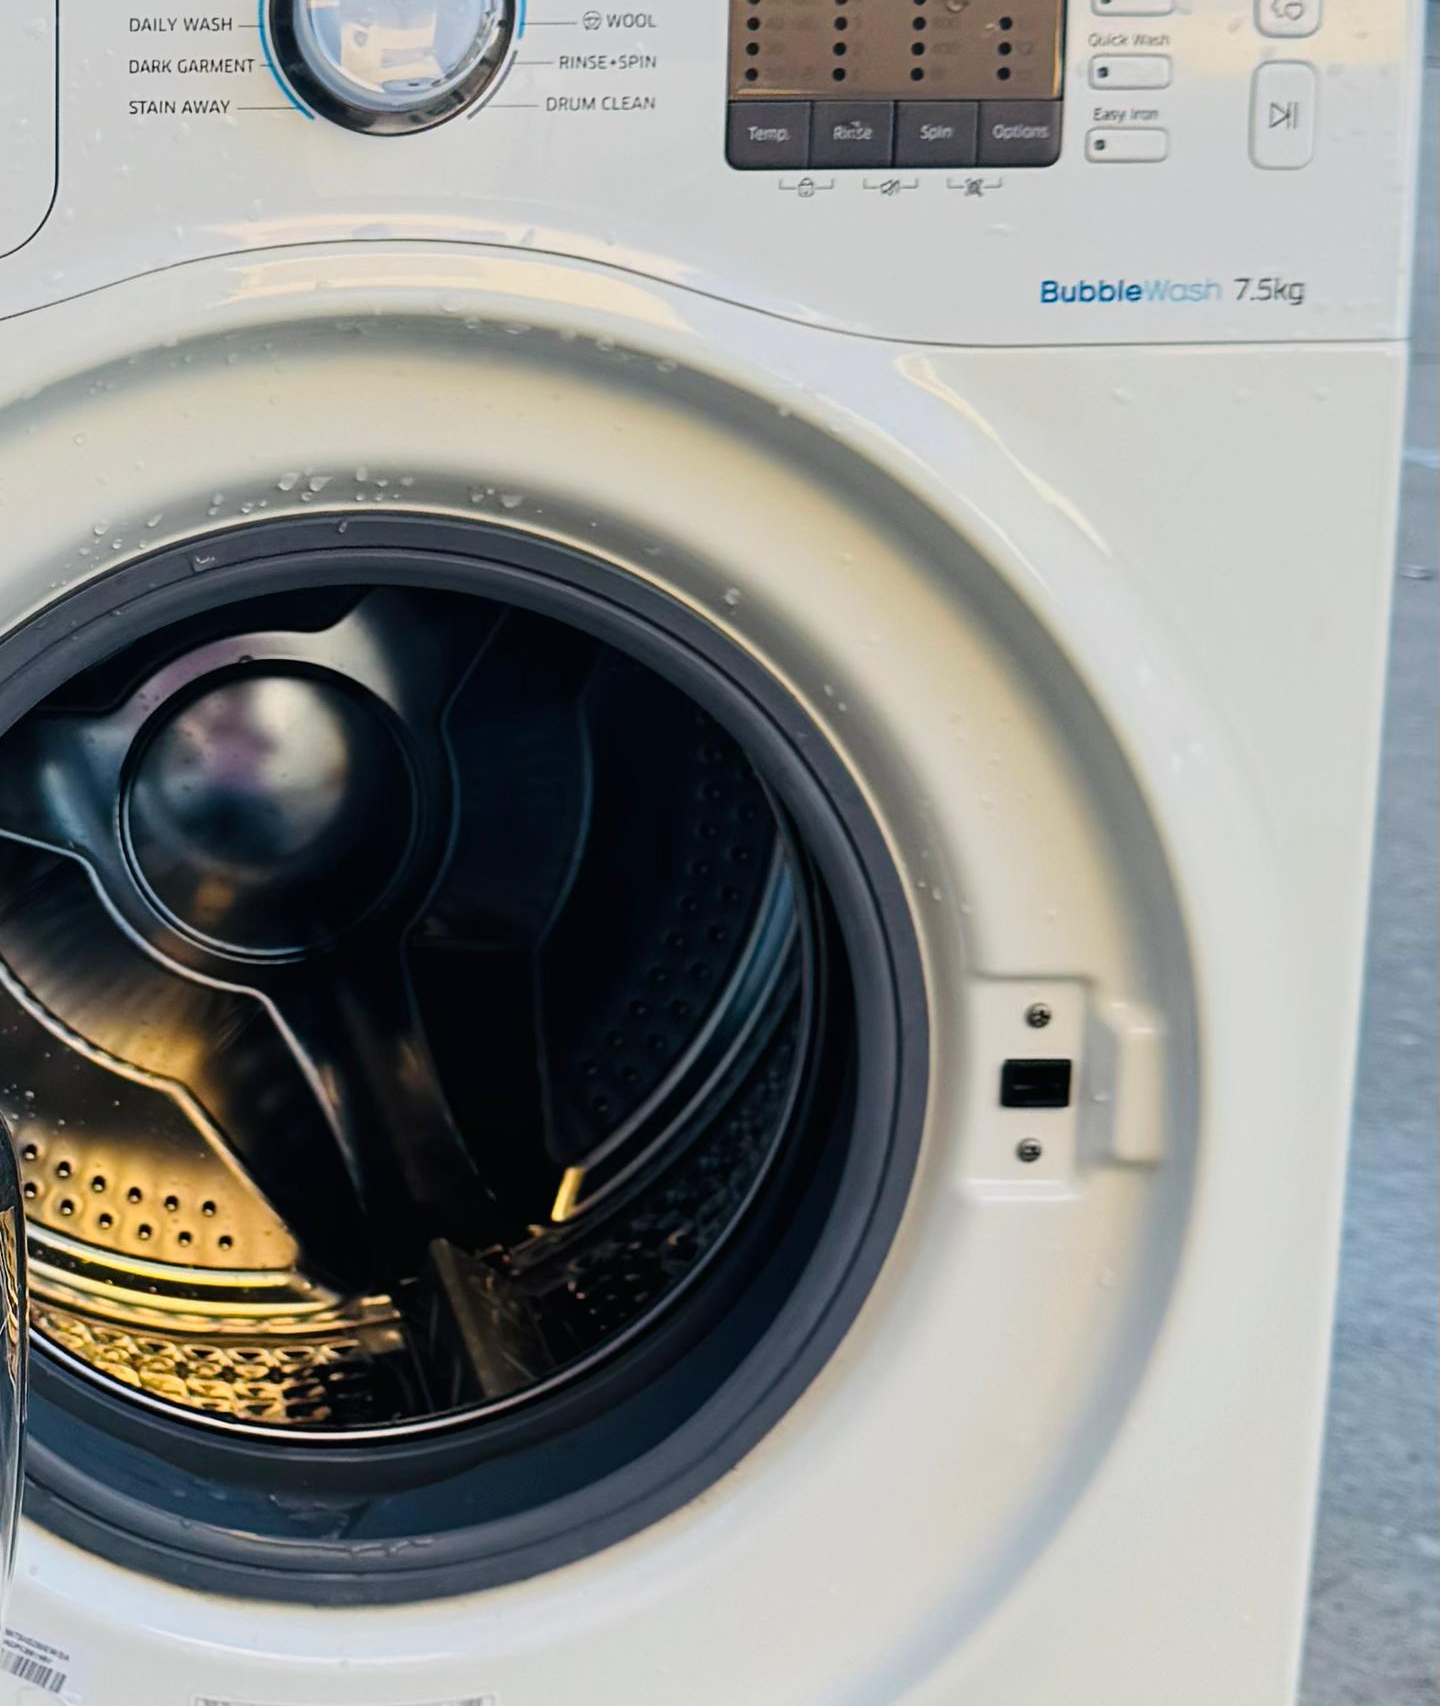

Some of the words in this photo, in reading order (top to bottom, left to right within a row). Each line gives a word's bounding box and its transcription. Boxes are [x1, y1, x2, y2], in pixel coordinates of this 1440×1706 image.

[129, 17, 178, 32] DAILY
[182, 17, 233, 31] WASH
[607, 14, 657, 28] WOOL
[1088, 34, 1128, 48] Quick
[1132, 33, 1169, 47] Wash
[129, 59, 171, 73] DARK
[177, 58, 255, 73] GARMENT
[559, 55, 657, 70] RINSE+SPIN
[129, 101, 175, 114] STAIN
[181, 100, 229, 114] AWAY
[546, 97, 596, 112] DRUM
[600, 97, 655, 111] CLEAN
[1093, 107, 1126, 123] Easy
[920, 125, 953, 141] Spin
[993, 124, 1048, 141] Options
[1233, 279, 1305, 305] 7.5kg
